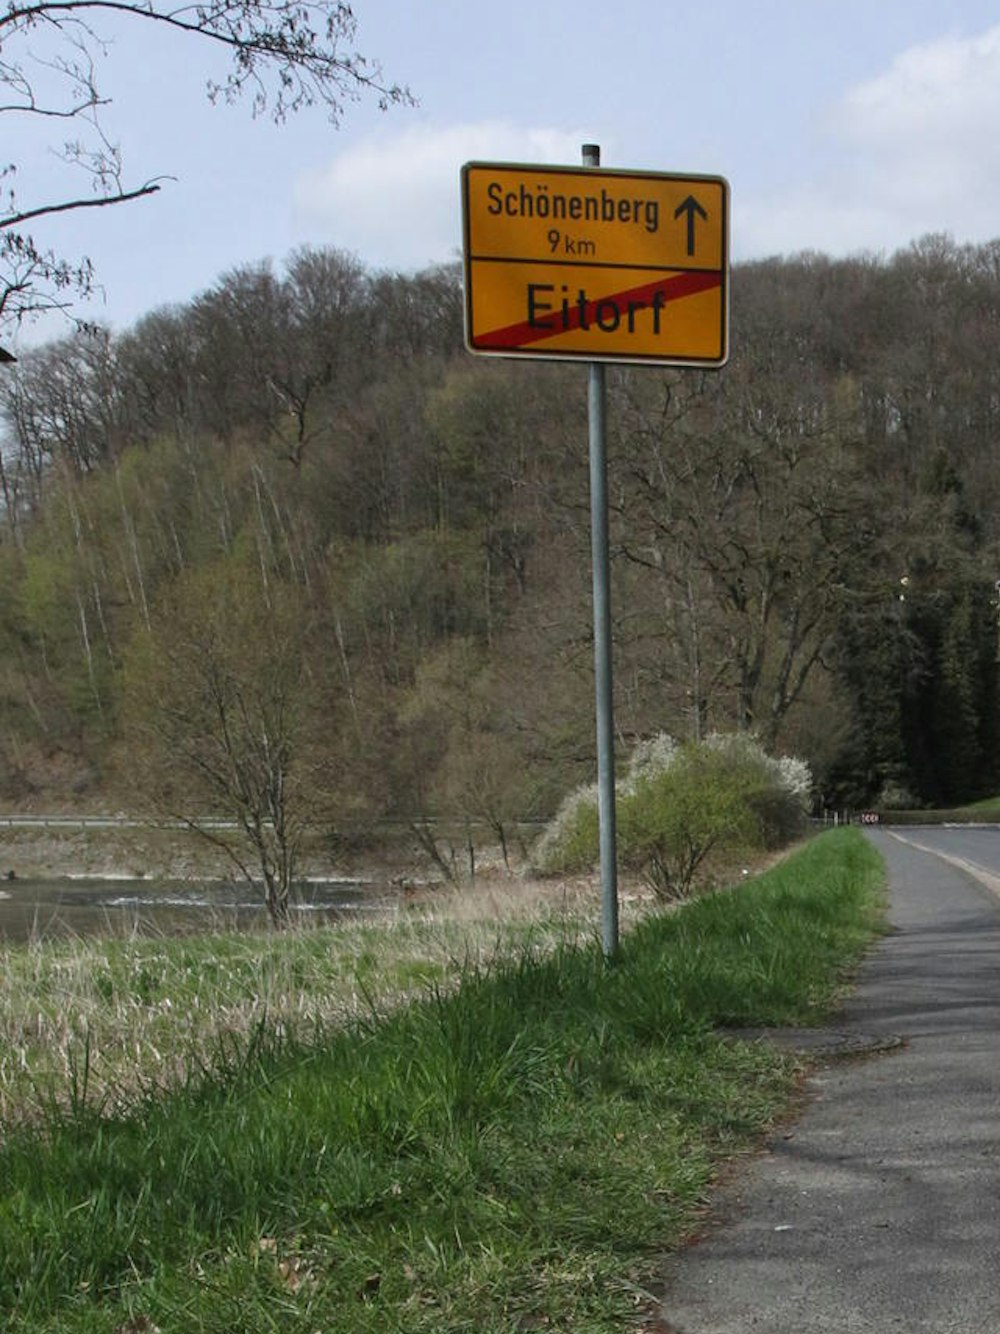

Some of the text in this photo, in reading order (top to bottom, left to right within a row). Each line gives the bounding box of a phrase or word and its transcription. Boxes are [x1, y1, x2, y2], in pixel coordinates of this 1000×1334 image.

[487, 182, 660, 233] Schönenberg
[547, 229, 596, 255] 9 km
[526, 283, 667, 335] Eitorf
